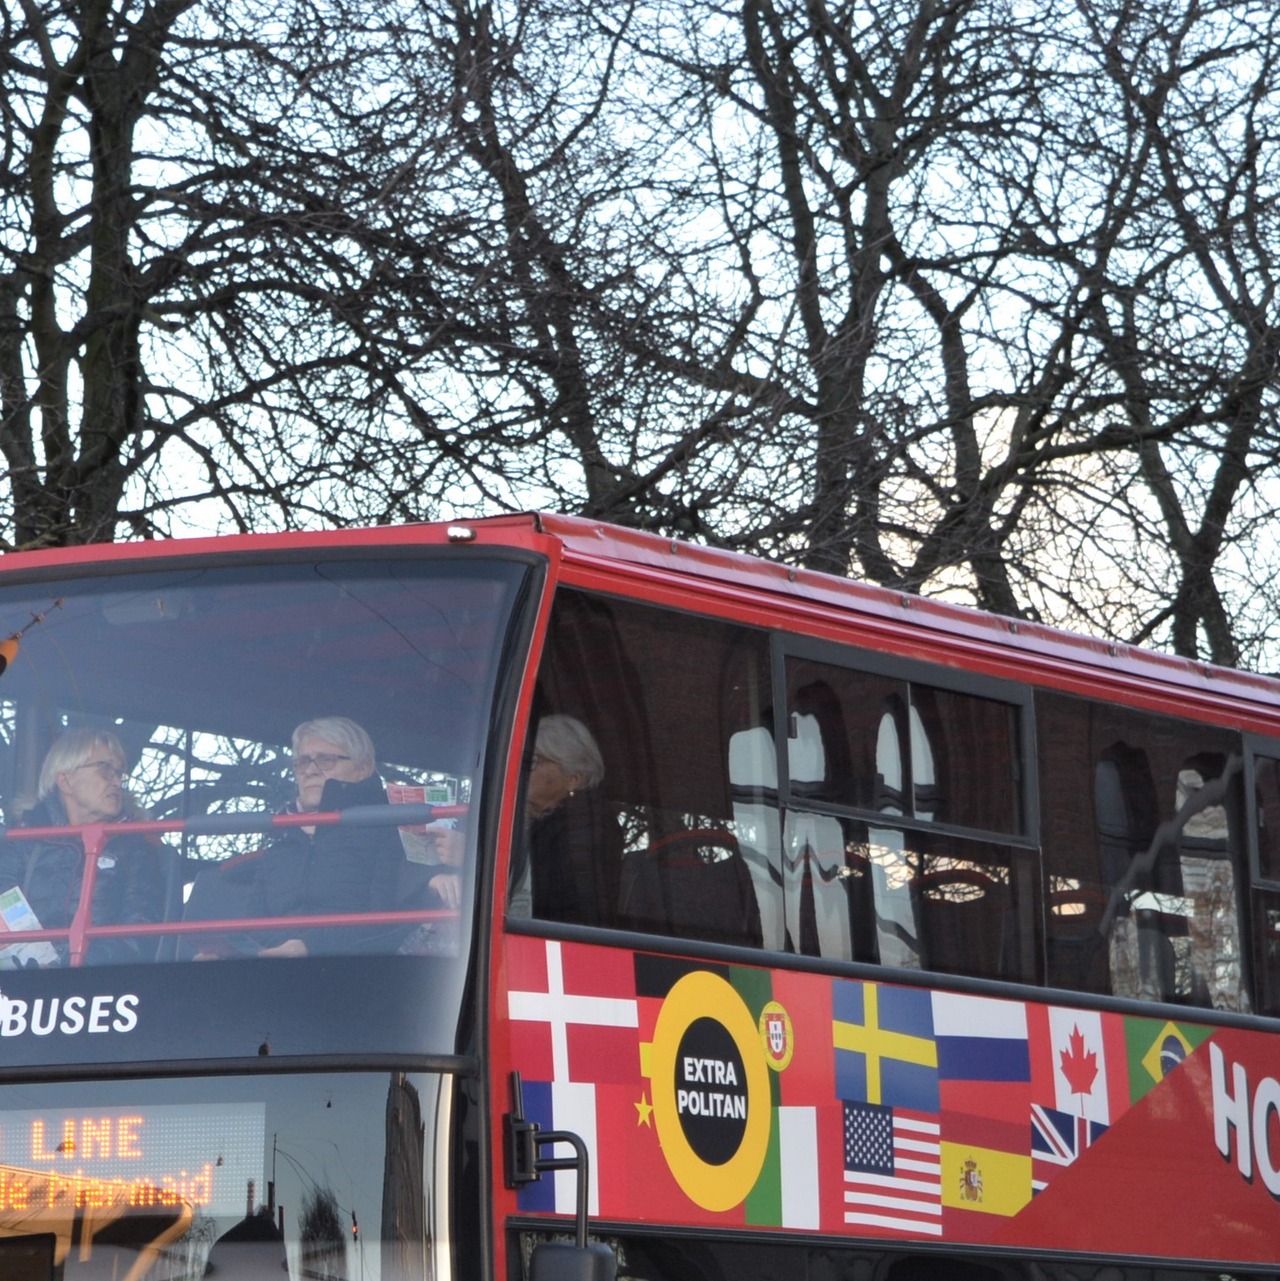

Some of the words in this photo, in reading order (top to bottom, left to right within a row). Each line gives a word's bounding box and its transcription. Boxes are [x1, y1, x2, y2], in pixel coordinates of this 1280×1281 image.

[683, 1057, 738, 1086] EXTRA
[677, 1089, 746, 1120] POLITAN
[32, 1115, 144, 1160] LINE
